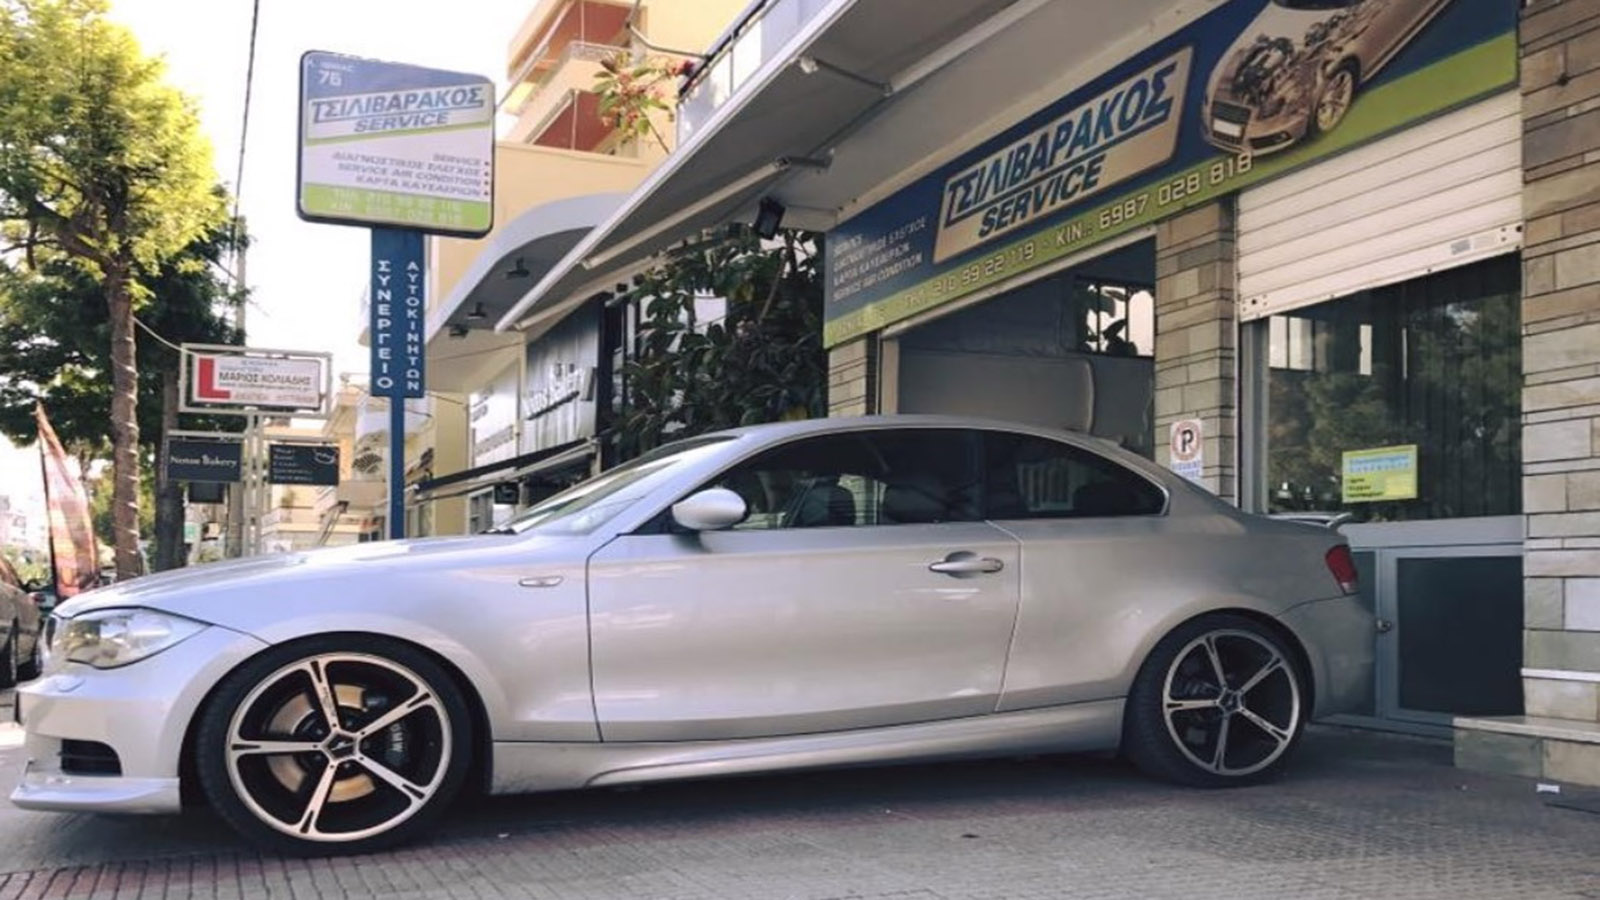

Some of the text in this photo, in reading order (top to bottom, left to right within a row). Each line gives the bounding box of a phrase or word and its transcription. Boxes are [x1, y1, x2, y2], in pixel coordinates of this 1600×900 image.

[318, 68, 342, 87] 76
[312, 87, 483, 123] ΤΣΙΛΙΒΑΡΑΚΟΣ
[354, 112, 449, 132] SERVICE
[433, 153, 480, 166] SERVICE
[944, 61, 1177, 229] ΤΣΙΛΙΒΑΡΑΚΟΣ
[338, 162, 481, 187] SERVICE AIR CONDITION
[356, 175, 398, 187] ΚΑΡΤΑ
[978, 154, 1107, 238] SERVICE
[984, 255, 1005, 276] 22
[1099, 193, 1150, 230] 6987
[1158, 172, 1200, 206] 028
[1210, 152, 1251, 185] 818
[377, 260, 393, 389] ΣΥΝΕΡΓΕΙΟ
[406, 261, 420, 391] ΑΥΤΟΚΙΝΗΤΩΝ
